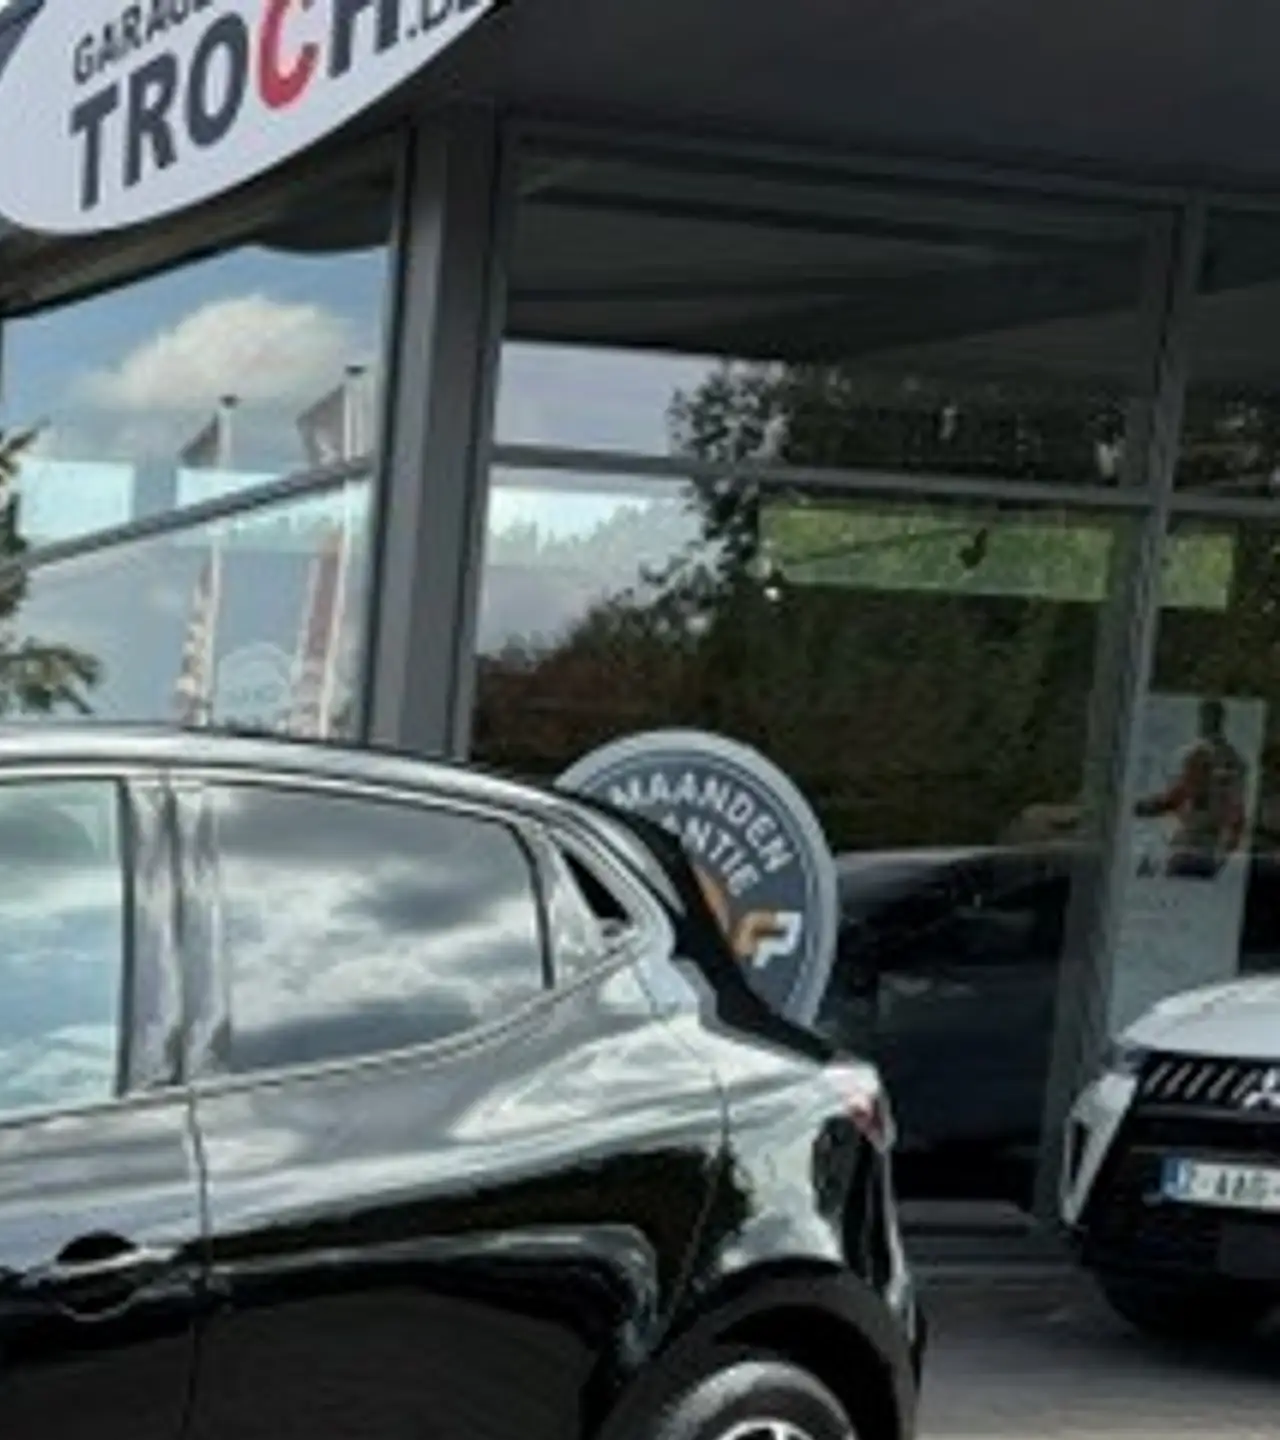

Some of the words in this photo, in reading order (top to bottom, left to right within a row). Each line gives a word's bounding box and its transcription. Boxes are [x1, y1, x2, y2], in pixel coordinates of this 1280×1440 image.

[72, 0, 214, 84] GARAG
[69, 0, 482, 211] TROCH.
[608, 771, 795, 874] MAANDEN
[659, 811, 761, 897] ANTIE
